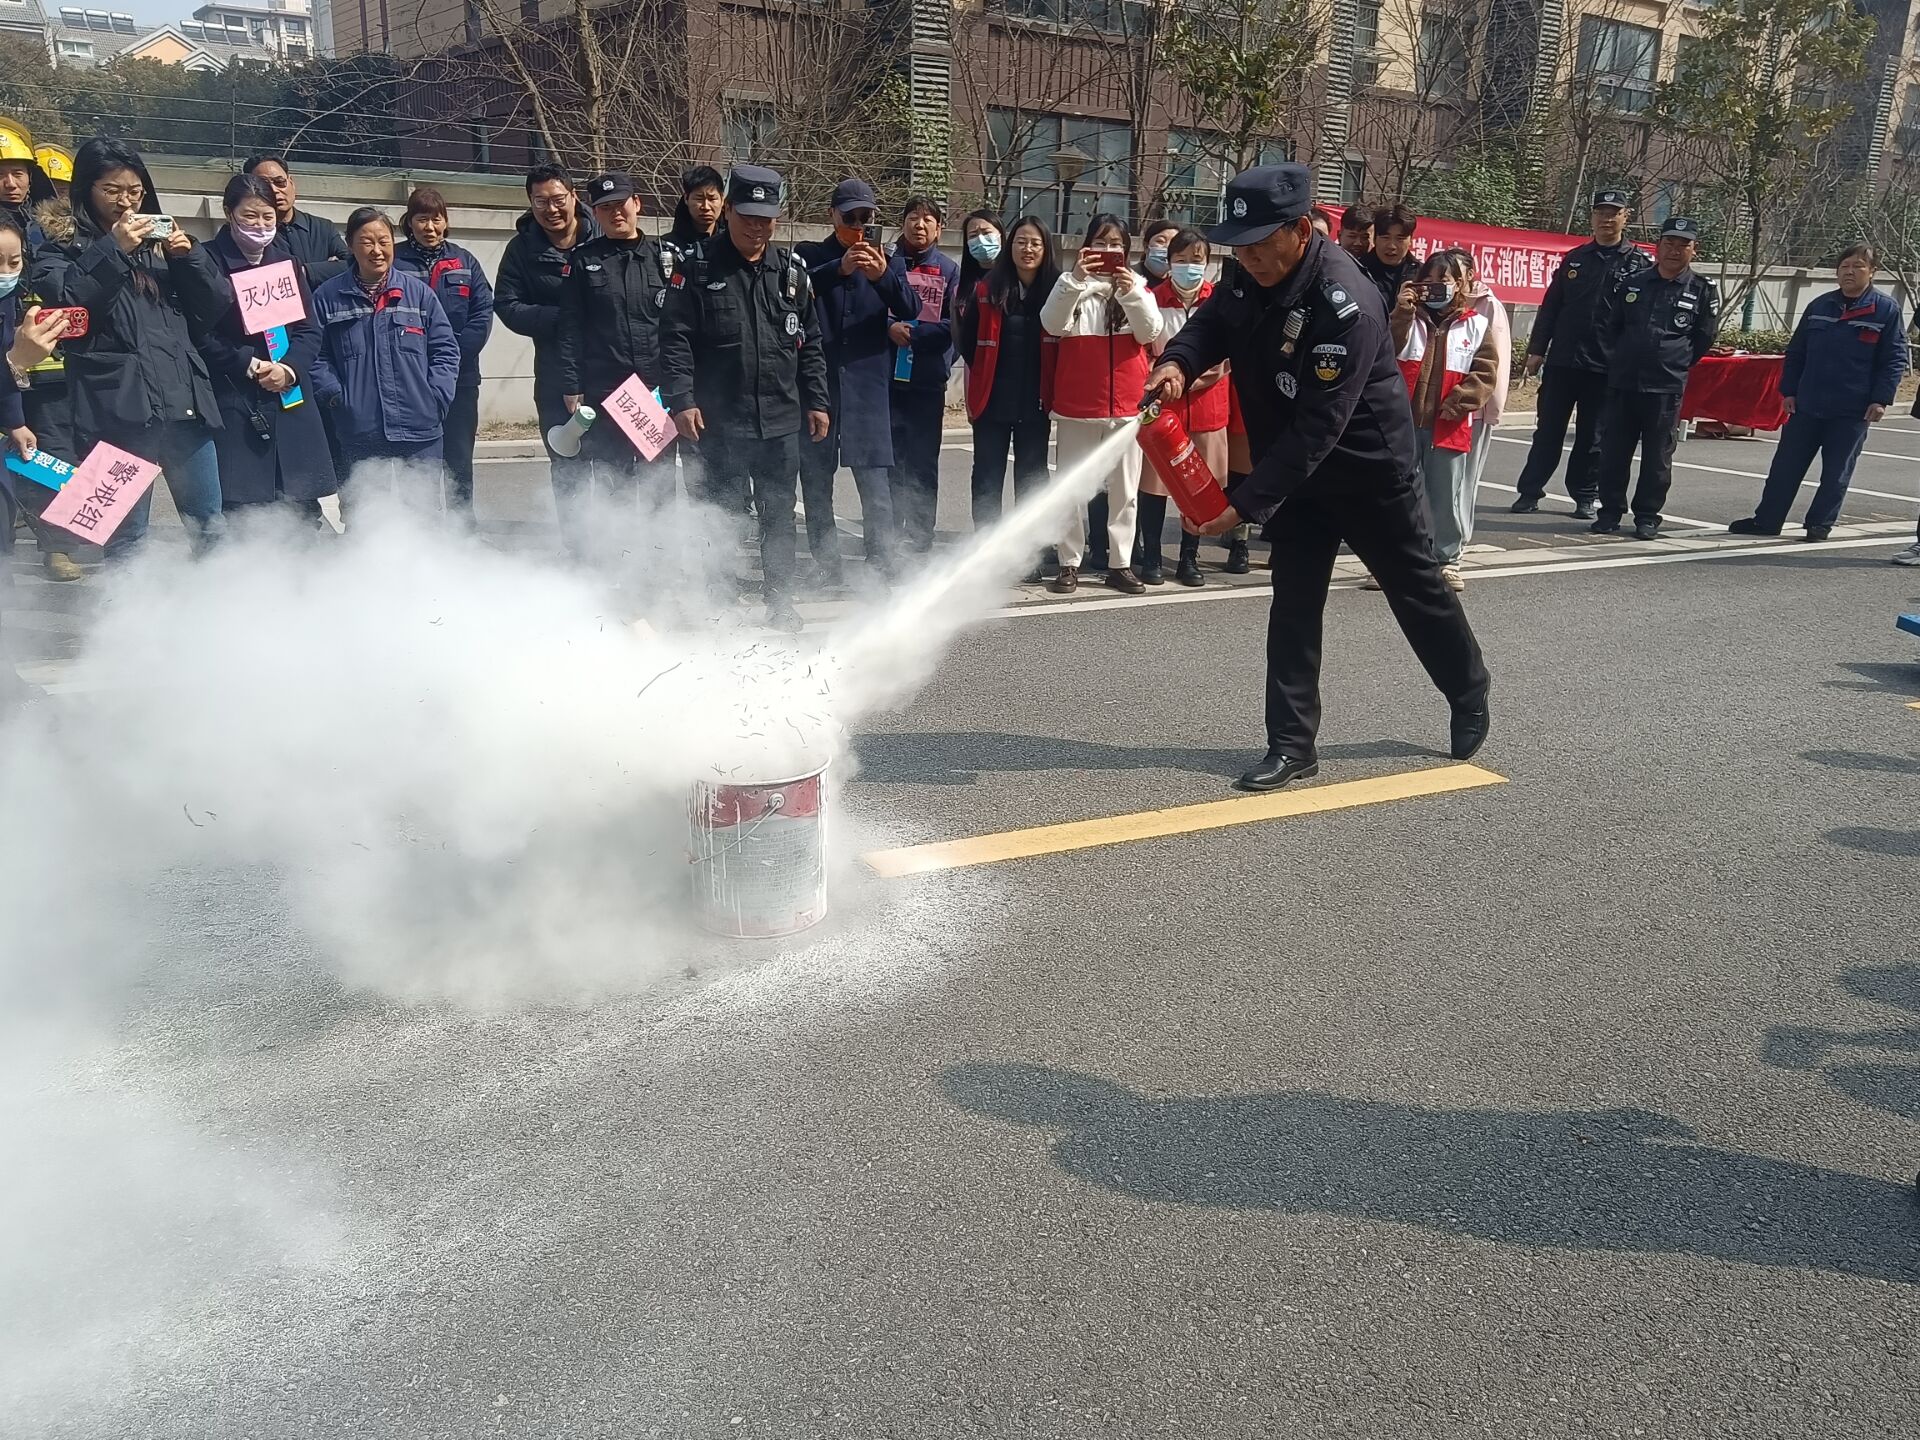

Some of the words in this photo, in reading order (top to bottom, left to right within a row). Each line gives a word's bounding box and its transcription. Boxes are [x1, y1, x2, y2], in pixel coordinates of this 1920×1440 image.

[242, 276, 297, 312] 灭火组
[615, 389, 664, 448] 疏散组
[69, 460, 139, 531] 警戒组
